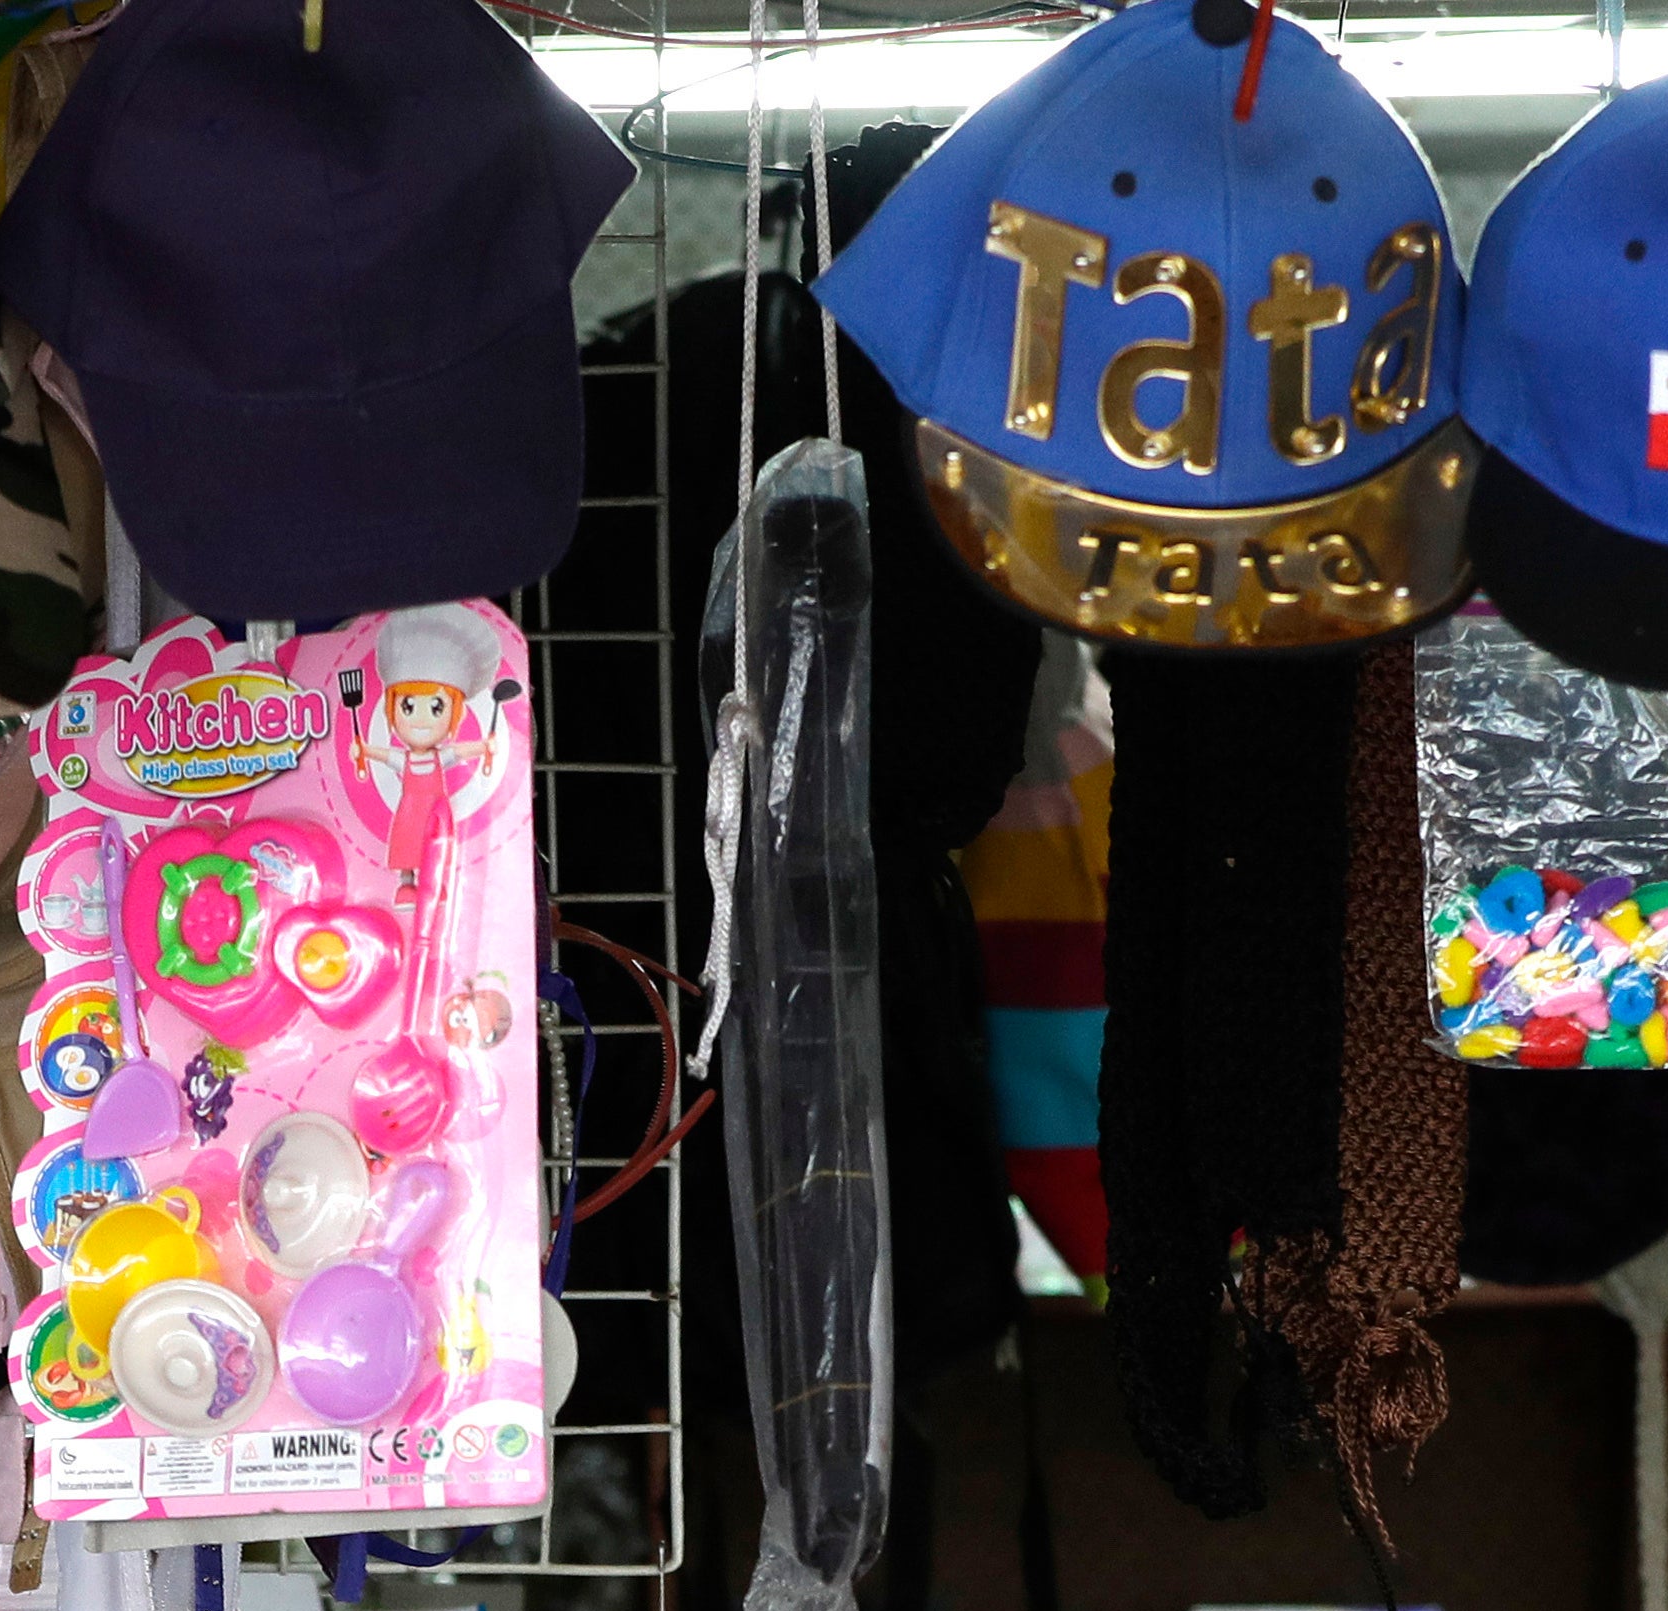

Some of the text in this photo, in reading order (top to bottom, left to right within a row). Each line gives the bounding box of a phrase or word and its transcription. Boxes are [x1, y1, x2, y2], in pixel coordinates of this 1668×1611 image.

[984, 198, 1443, 477] Tata
[117, 686, 327, 756] Kitchen
[65, 761, 82, 774] 3+
[142, 751, 297, 781] High class toys set
[271, 1433, 356, 1458] WARNING:
